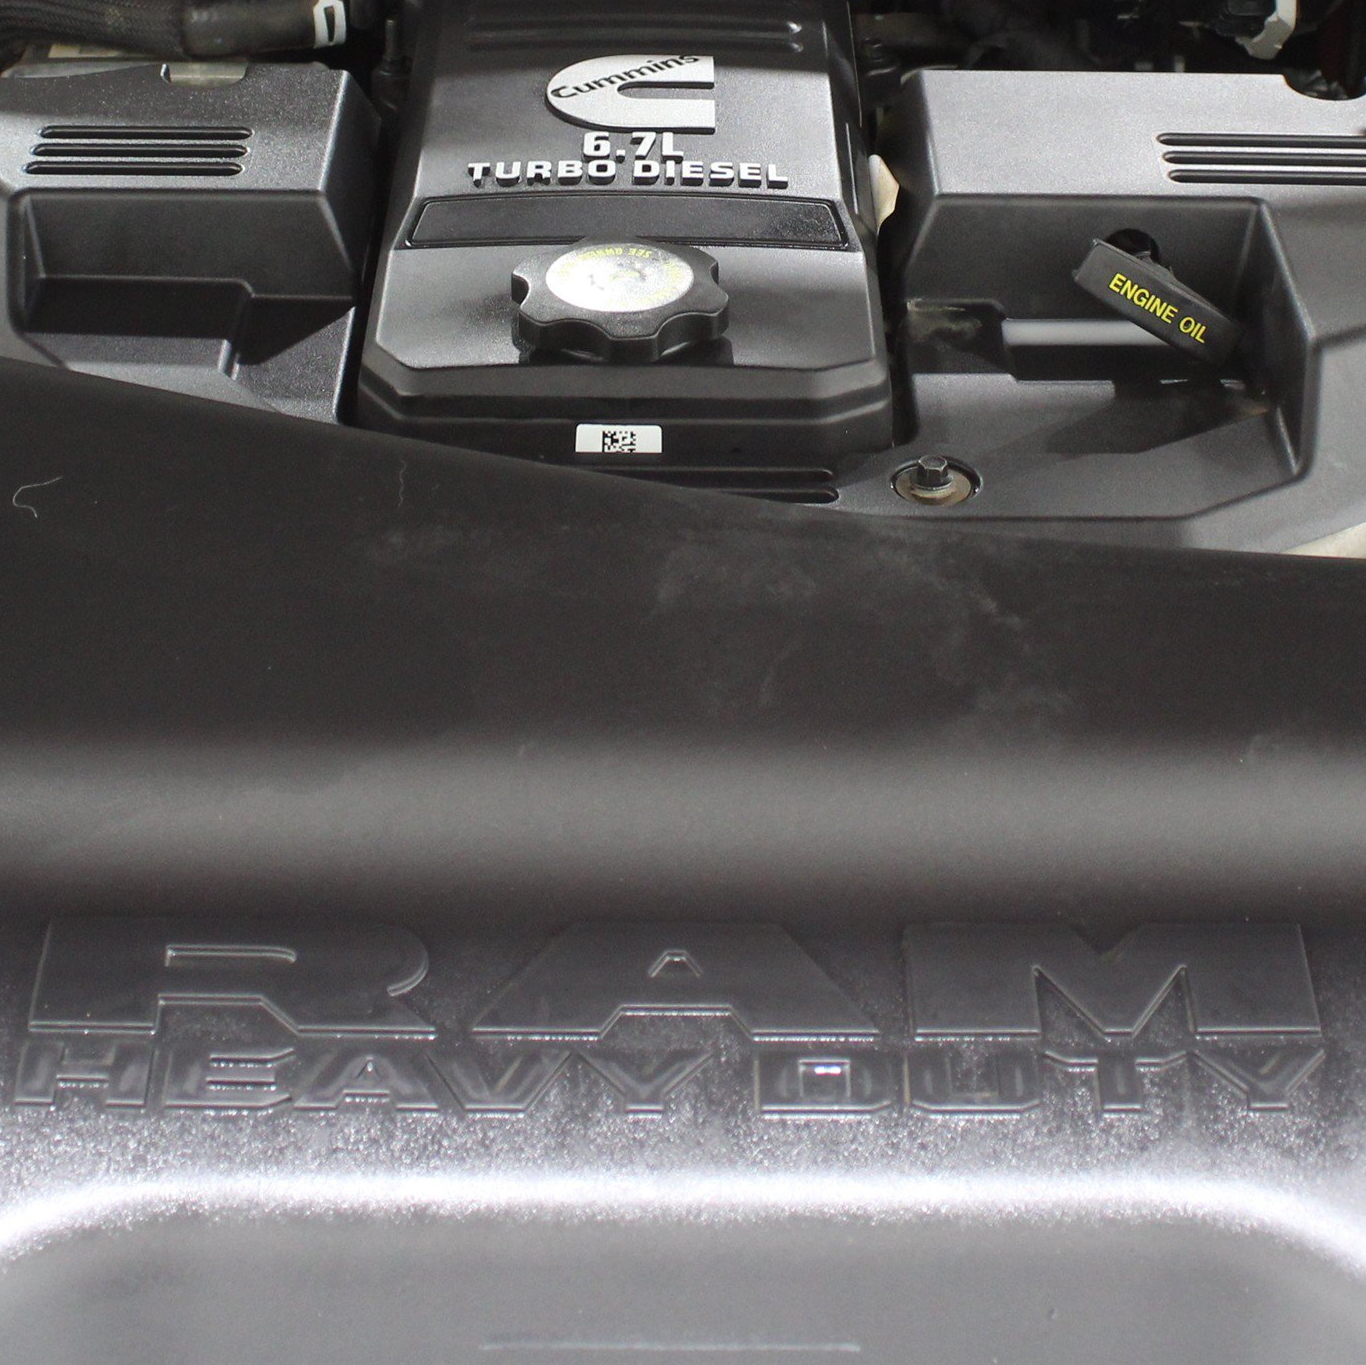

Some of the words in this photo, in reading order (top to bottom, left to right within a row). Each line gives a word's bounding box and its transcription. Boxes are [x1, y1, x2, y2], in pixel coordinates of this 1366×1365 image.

[550, 54, 700, 99] Cummins
[468, 160, 617, 186] TURBO
[632, 160, 789, 188] DIESEL
[582, 131, 684, 162] 6.7L
[1108, 273, 1179, 324] ENGINE
[1179, 316, 1208, 344] OIL
[23, 919, 1323, 1040] RAM
[13, 1041, 713, 1115] HEAVY
[755, 1045, 1327, 1118] DUTY
